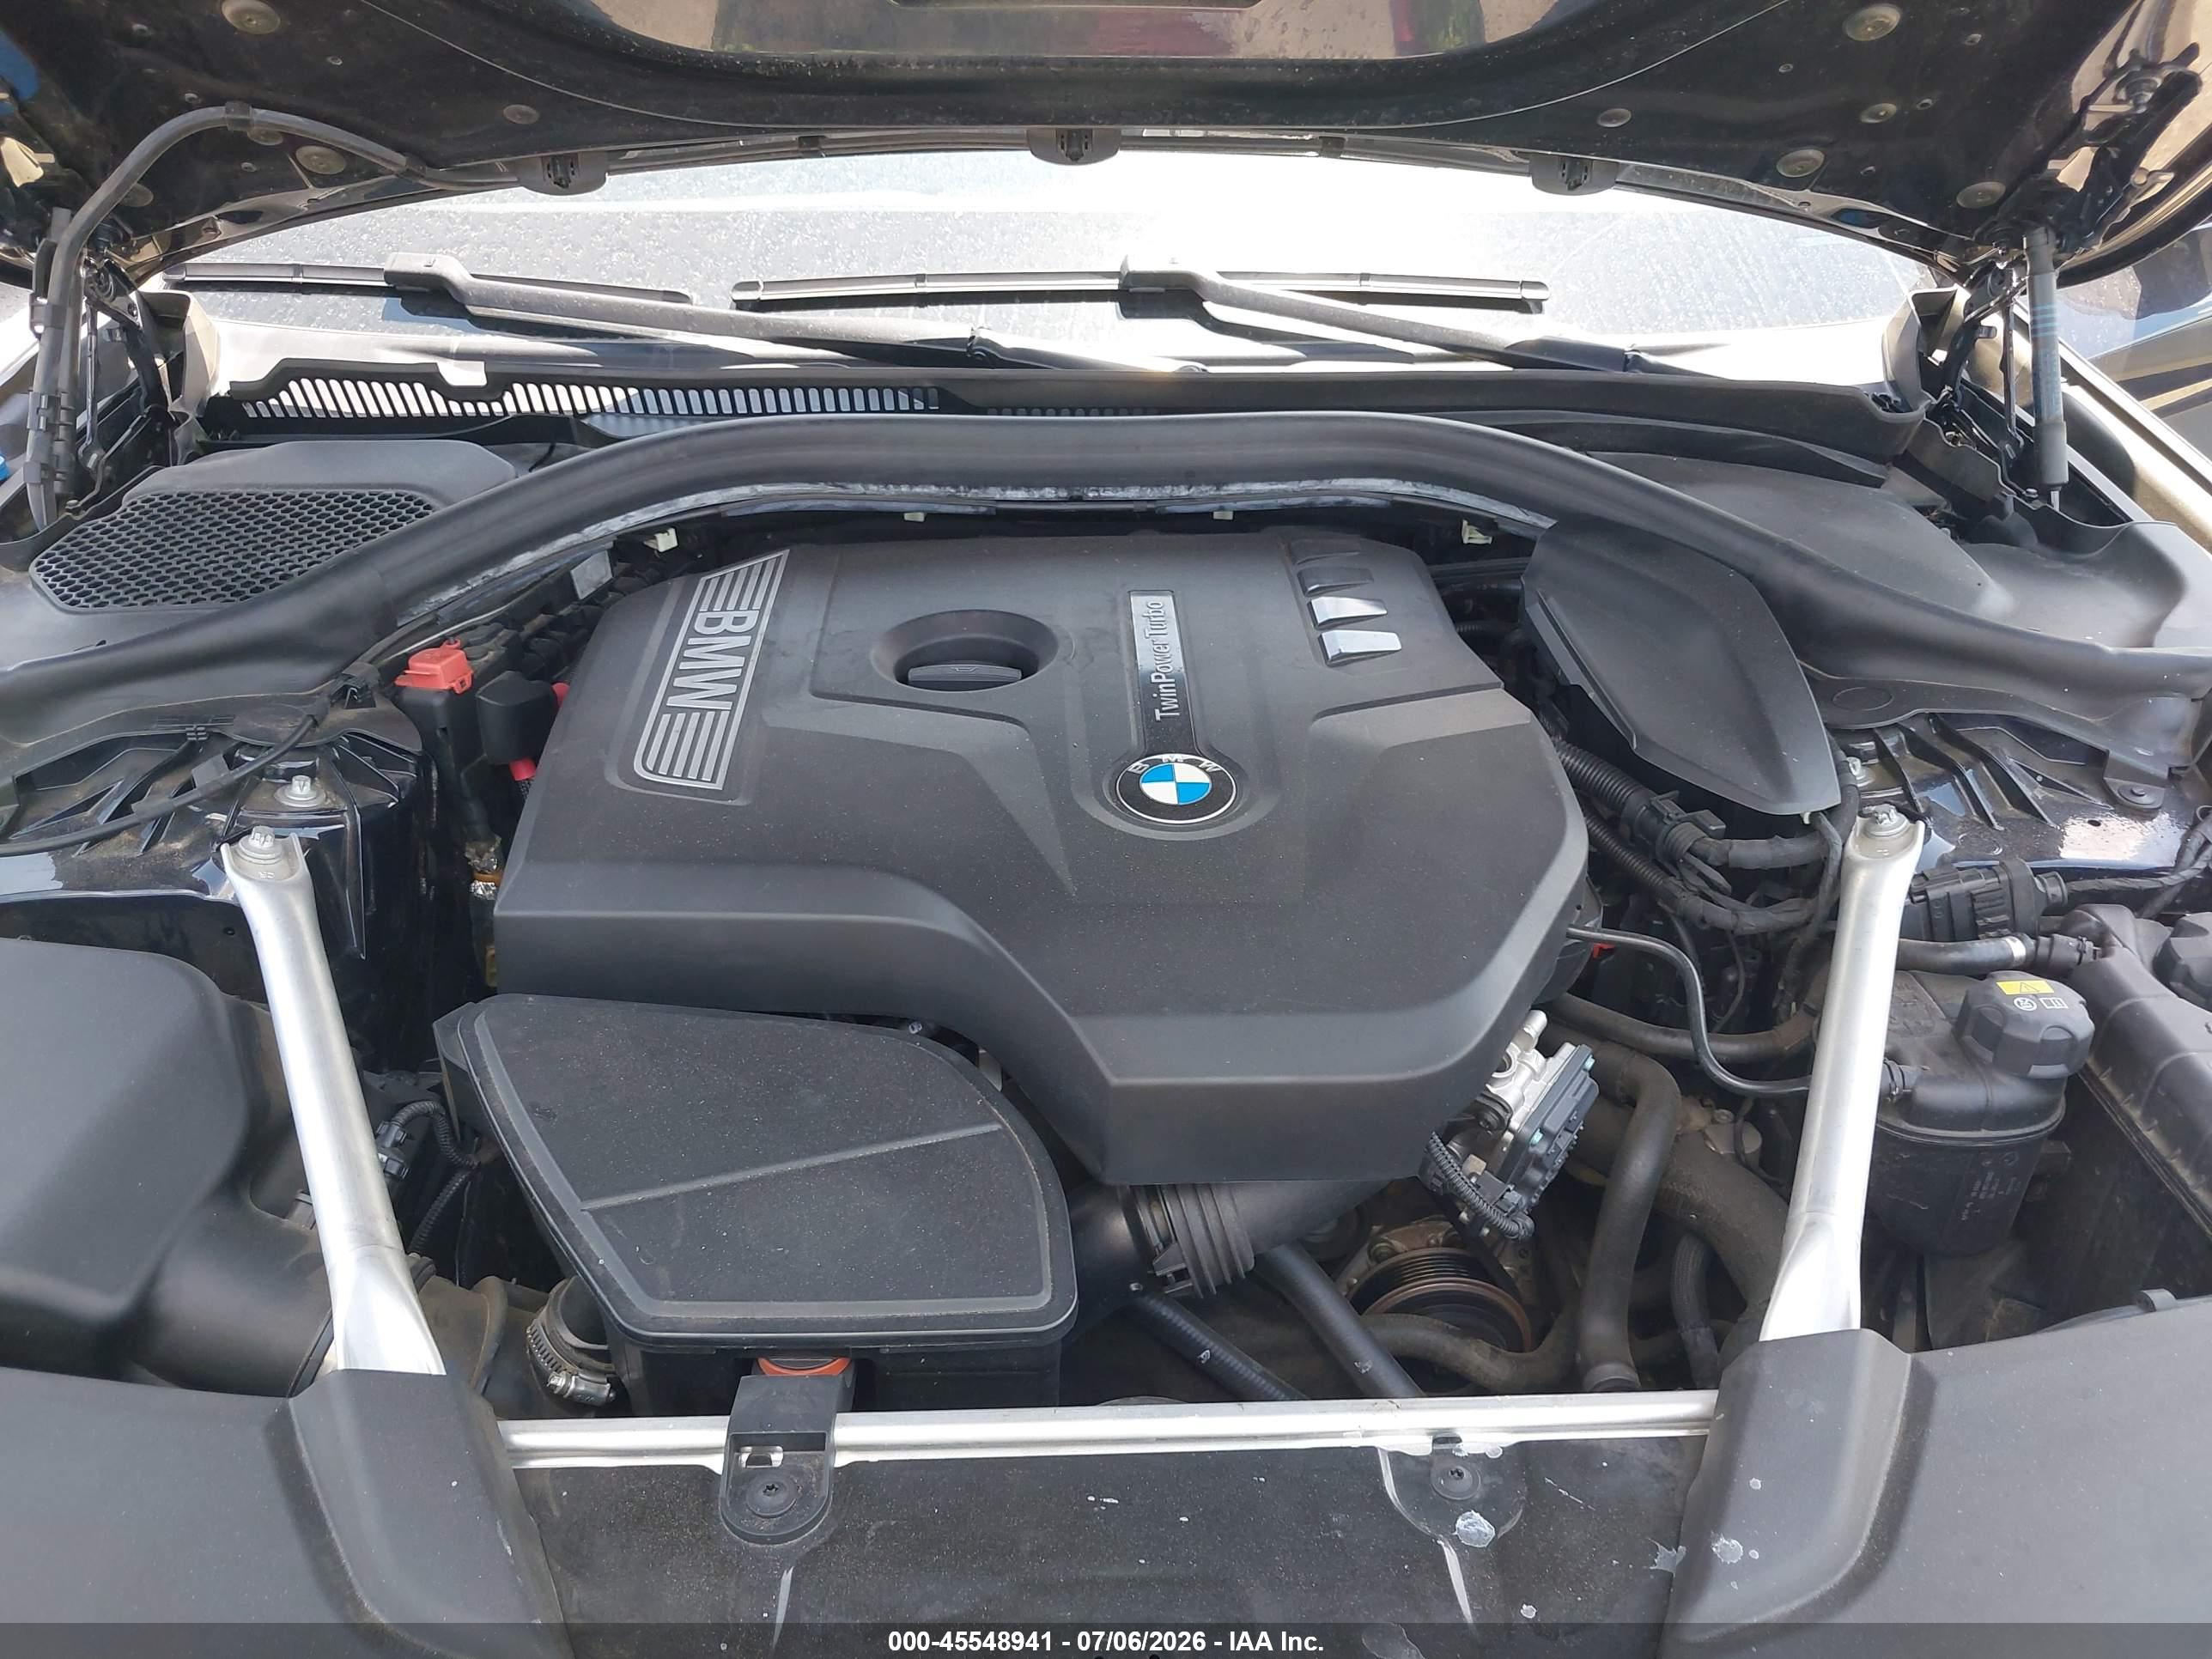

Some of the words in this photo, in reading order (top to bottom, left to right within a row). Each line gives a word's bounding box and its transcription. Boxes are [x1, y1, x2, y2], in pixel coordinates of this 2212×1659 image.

[1142, 601, 1169, 639] Turbo
[666, 610, 760, 710] BMW
[1150, 639, 1180, 721] TwinPower
[1127, 752, 1221, 774] BMW
